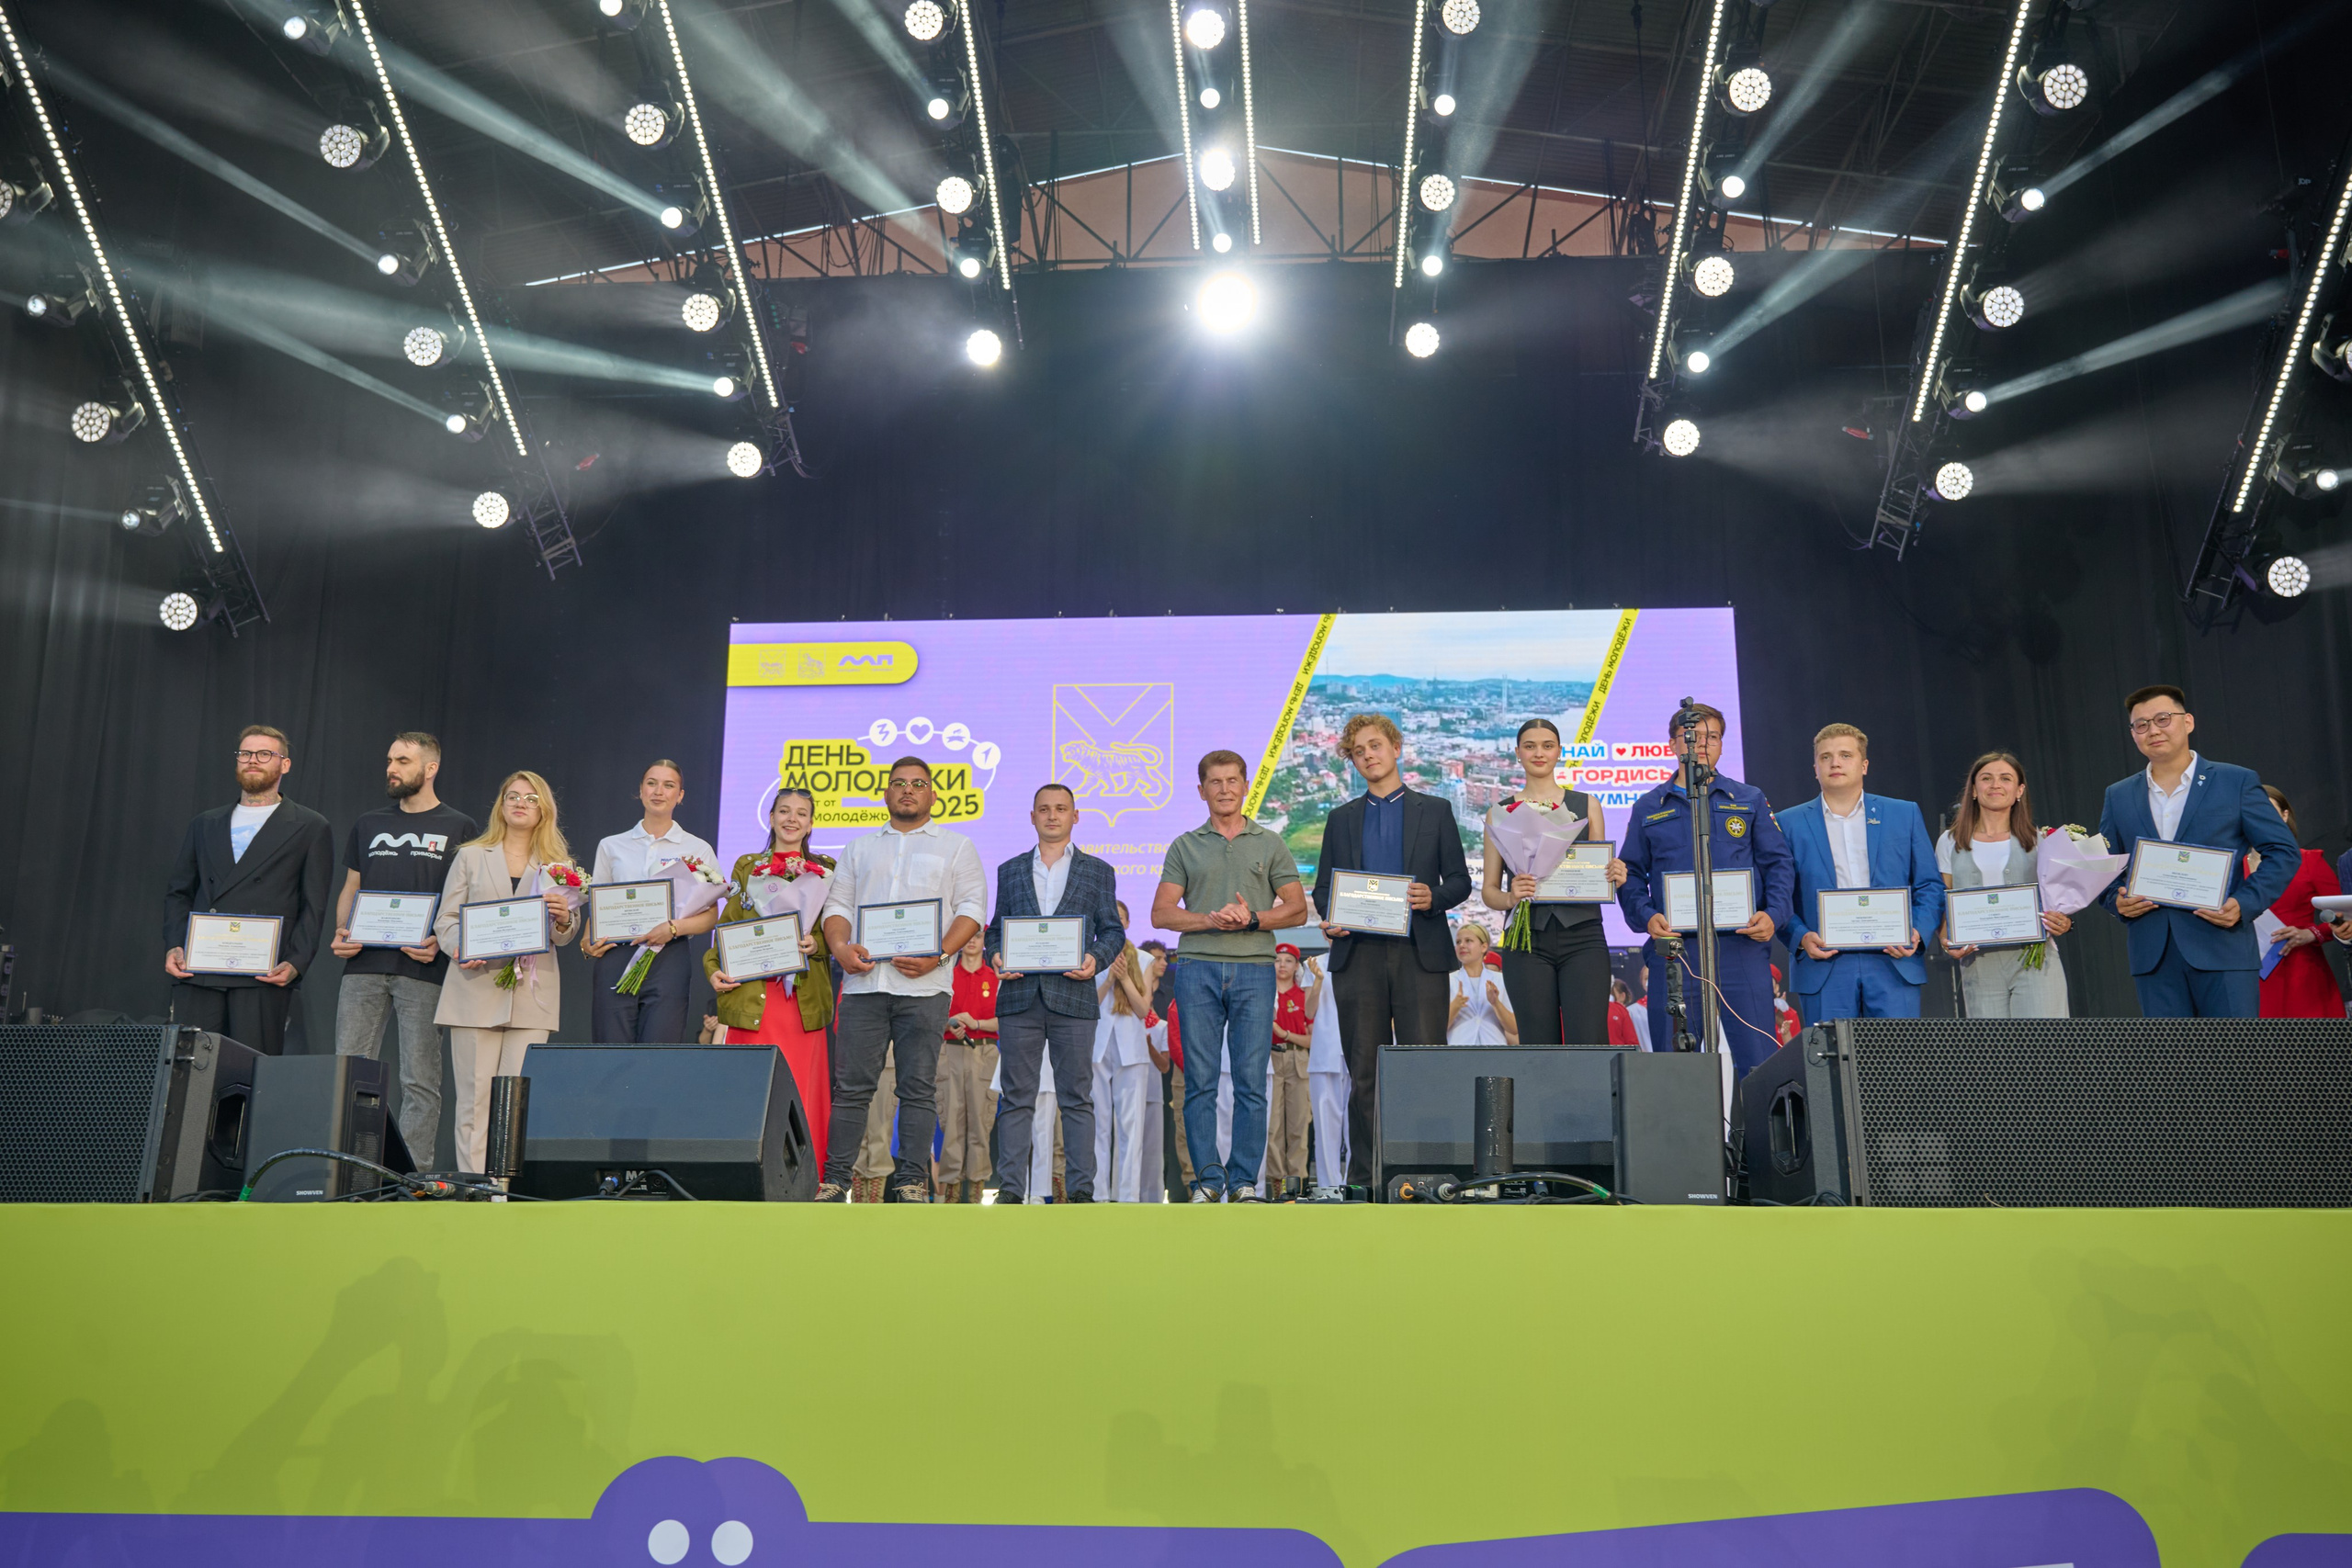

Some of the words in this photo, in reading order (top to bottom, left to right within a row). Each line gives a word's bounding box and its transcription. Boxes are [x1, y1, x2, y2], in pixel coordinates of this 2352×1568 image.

[1289, 682, 1304, 705] ДЕНЬ
[1598, 670, 1612, 694] ДЕНЬ
[1578, 701, 1601, 743] ОЛОДЁЖИ
[786, 745, 865, 771] ДЕНЬ
[1562, 743, 1605, 758] НАЙ
[1631, 745, 1676, 757] ЛЮБ
[786, 769, 966, 795] МОЛОДИ
[1256, 764, 1270, 789] ДЕНЬ
[1572, 769, 1673, 784] ГОРДИСЬ
[930, 794, 979, 818] 025
[1244, 790, 1261, 817] МОЛО
[1079, 842, 1171, 854] авительство
